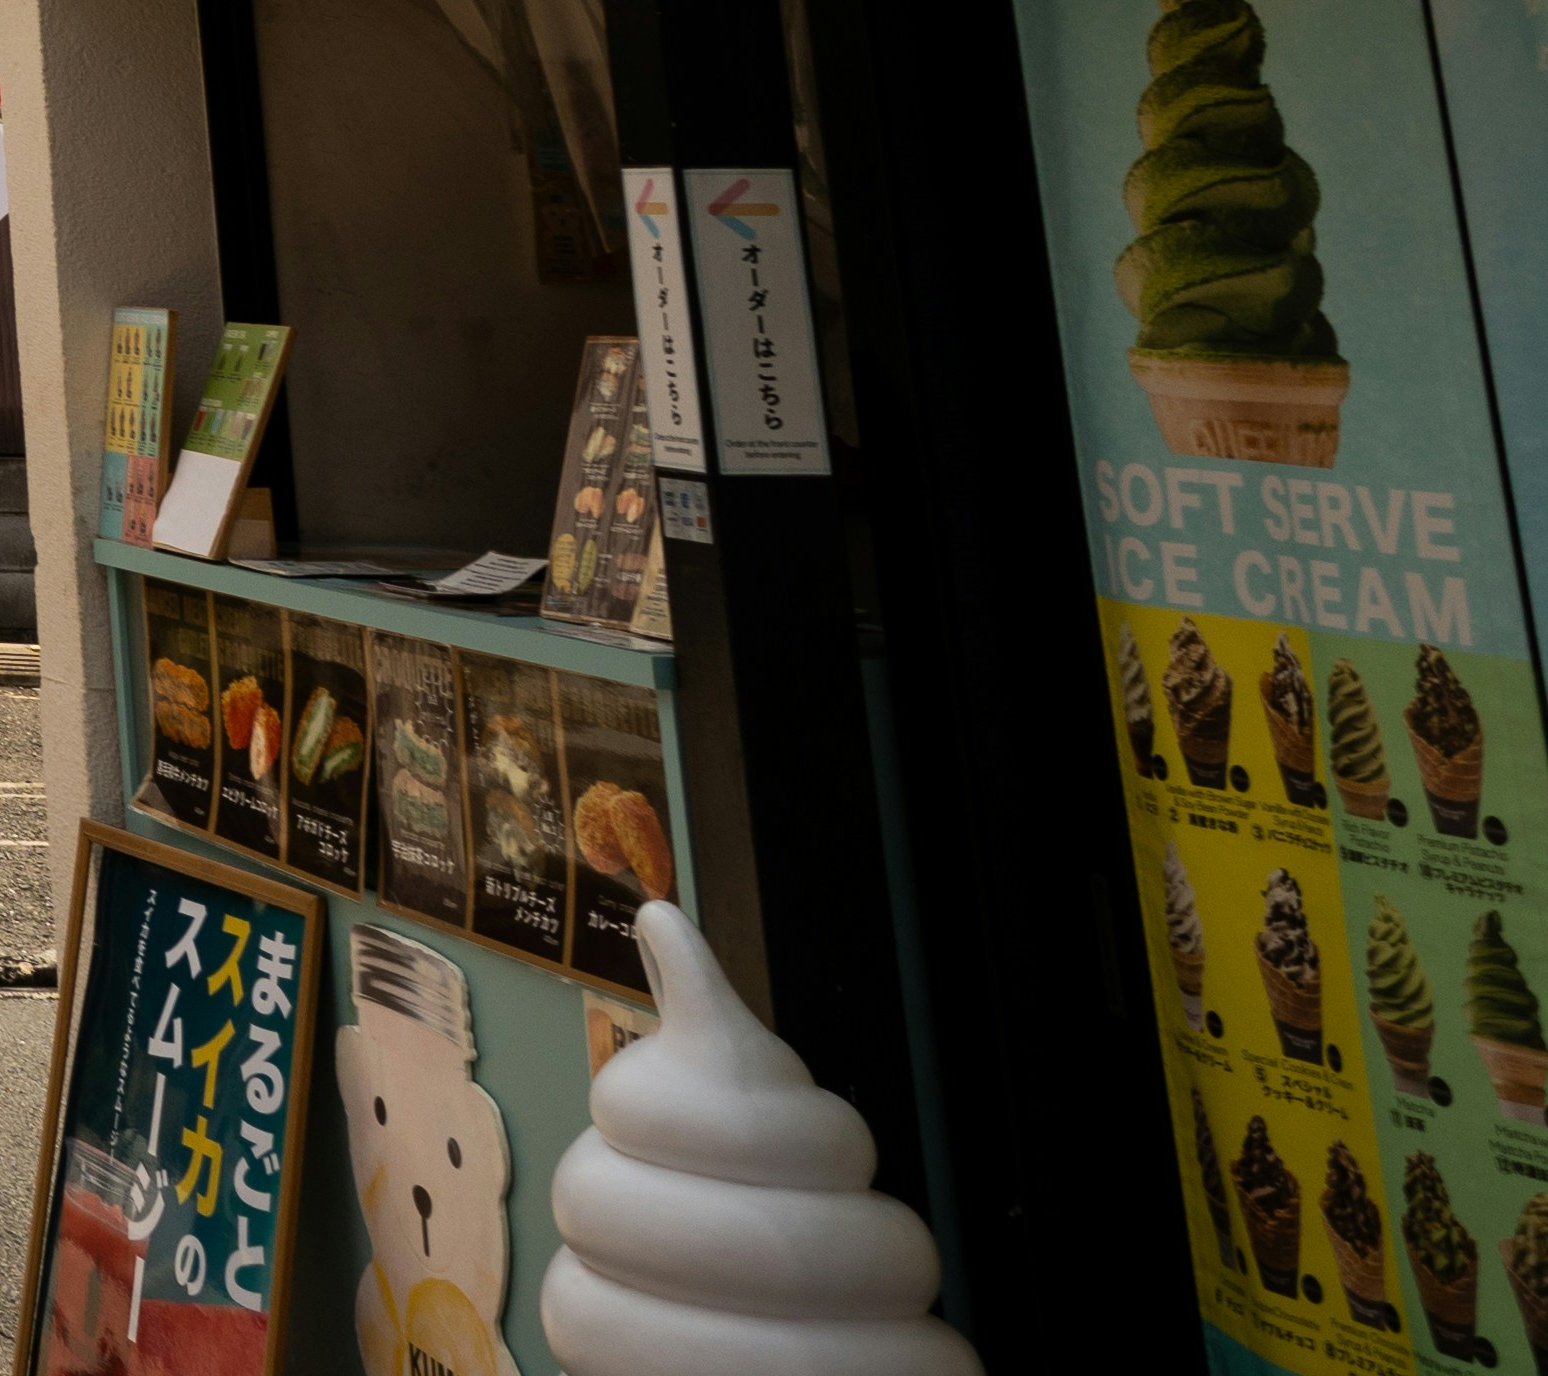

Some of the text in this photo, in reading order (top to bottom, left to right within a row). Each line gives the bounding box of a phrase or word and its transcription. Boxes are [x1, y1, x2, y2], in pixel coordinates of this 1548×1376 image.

[651, 242, 683, 428] オーダーはこちら
[742, 244, 784, 431] オーダーはこちら
[1095, 457, 1462, 565] SOFT SERVE
[1103, 532, 1472, 646] ICE CREAM
[126, 897, 209, 1343] スムージー
[222, 930, 299, 1312] まるごと
